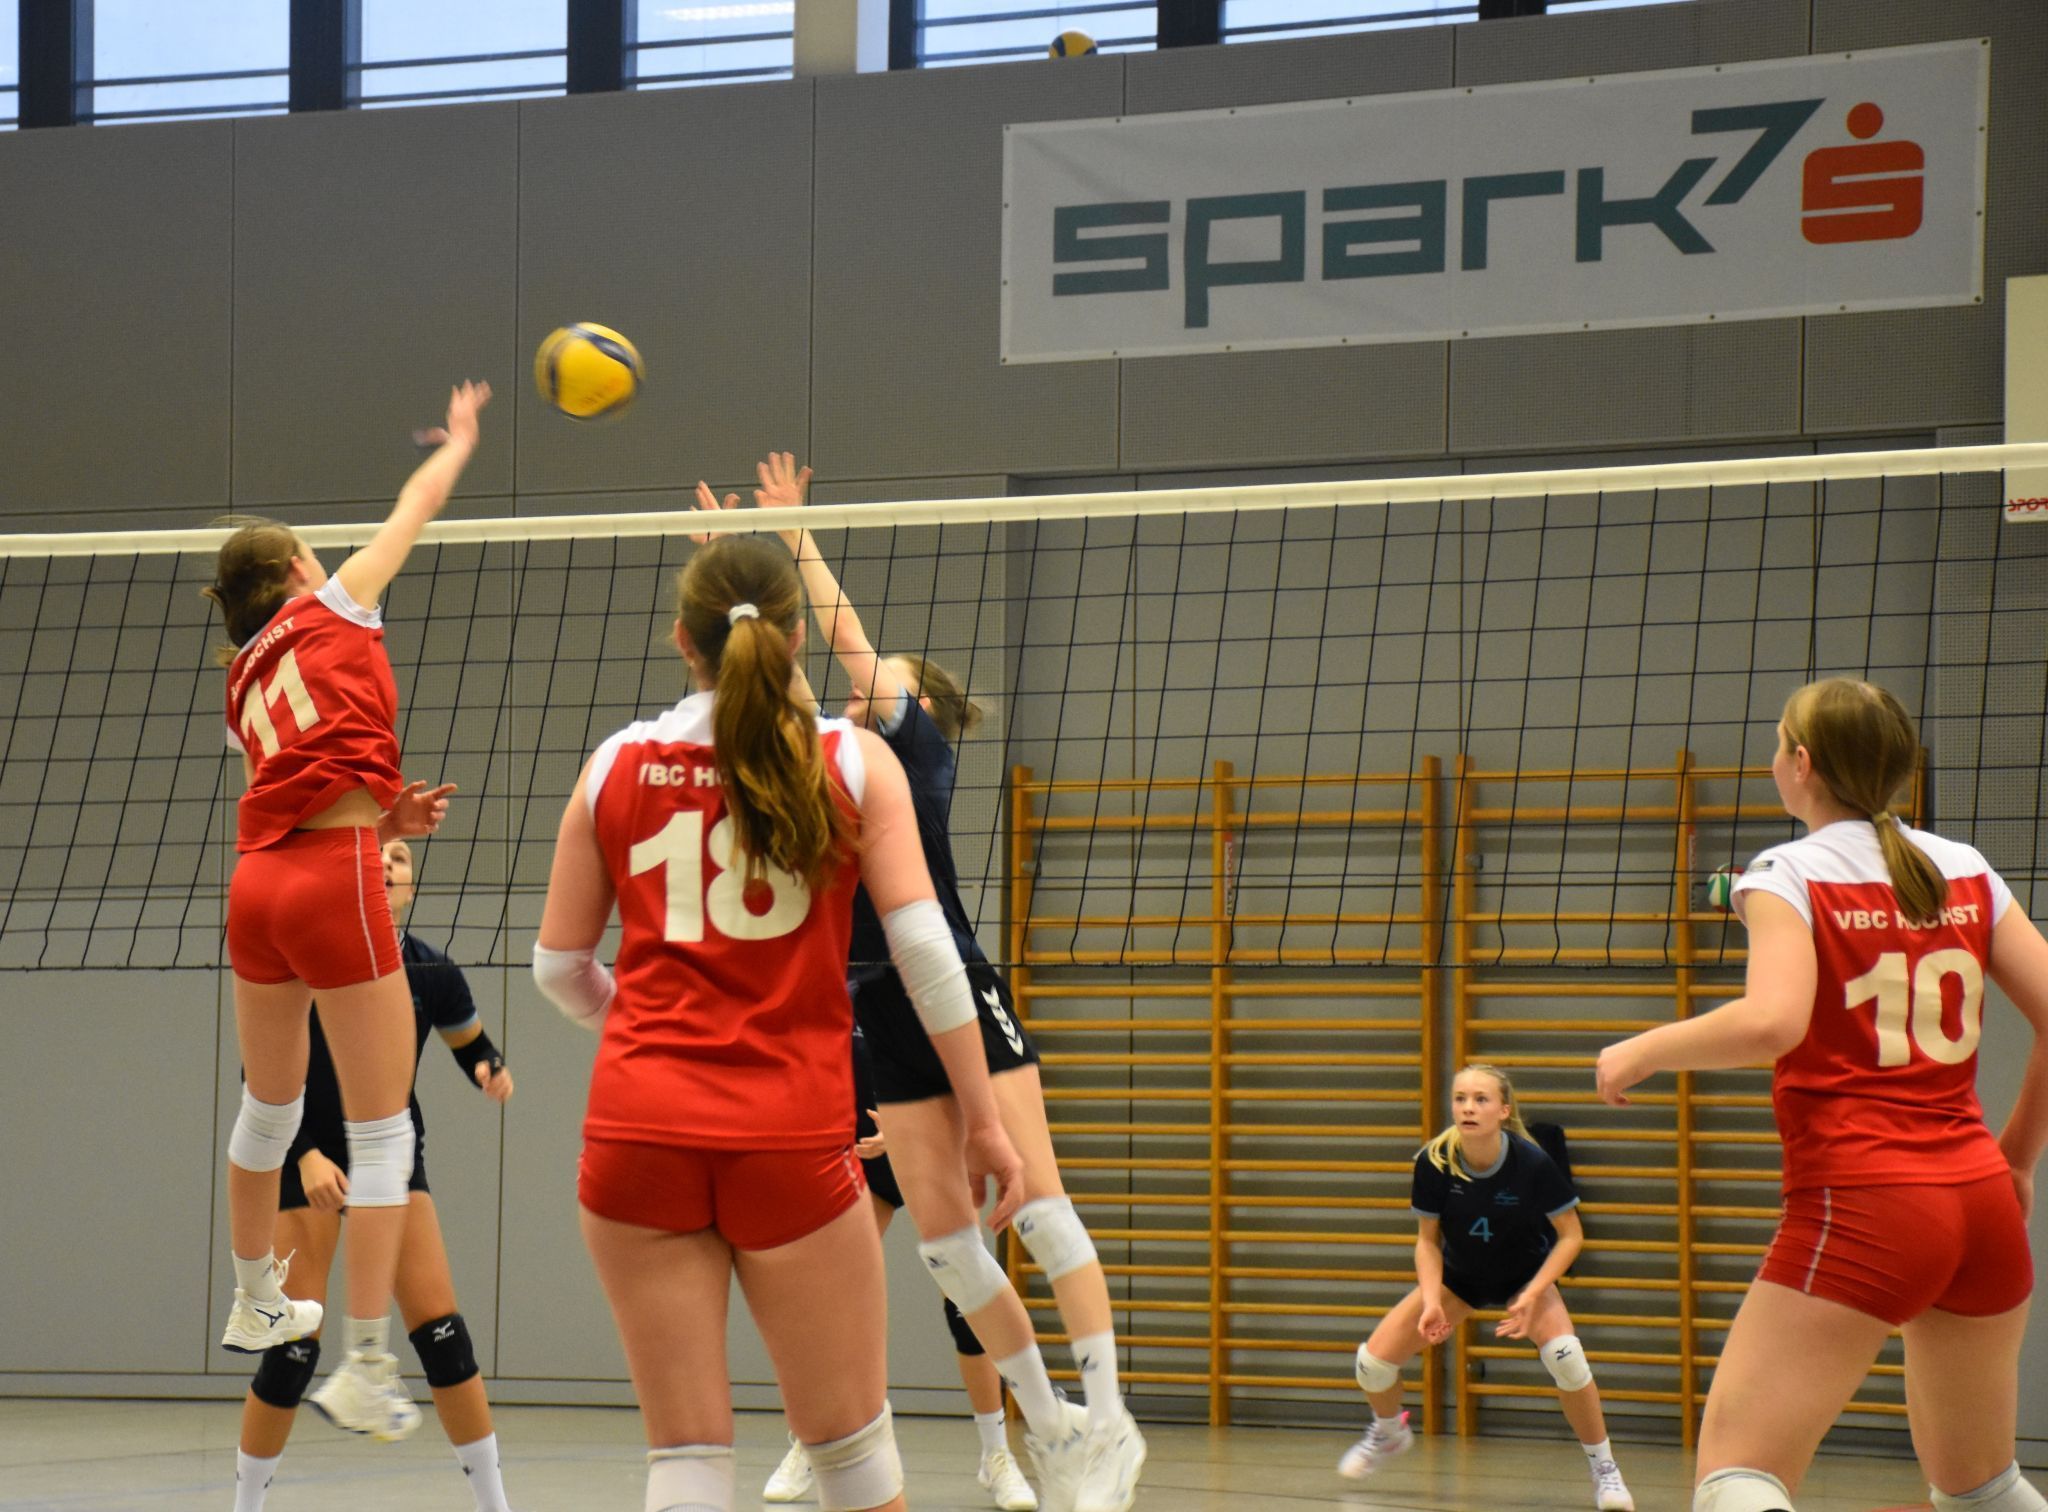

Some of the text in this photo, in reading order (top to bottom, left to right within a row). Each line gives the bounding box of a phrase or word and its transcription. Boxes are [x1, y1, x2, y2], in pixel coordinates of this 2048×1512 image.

[240, 648, 320, 759] 11
[630, 810, 811, 941] 18
[1833, 910, 1888, 930] VBC
[1845, 948, 1984, 1067] 10
[1468, 1216, 1494, 1242] 4
